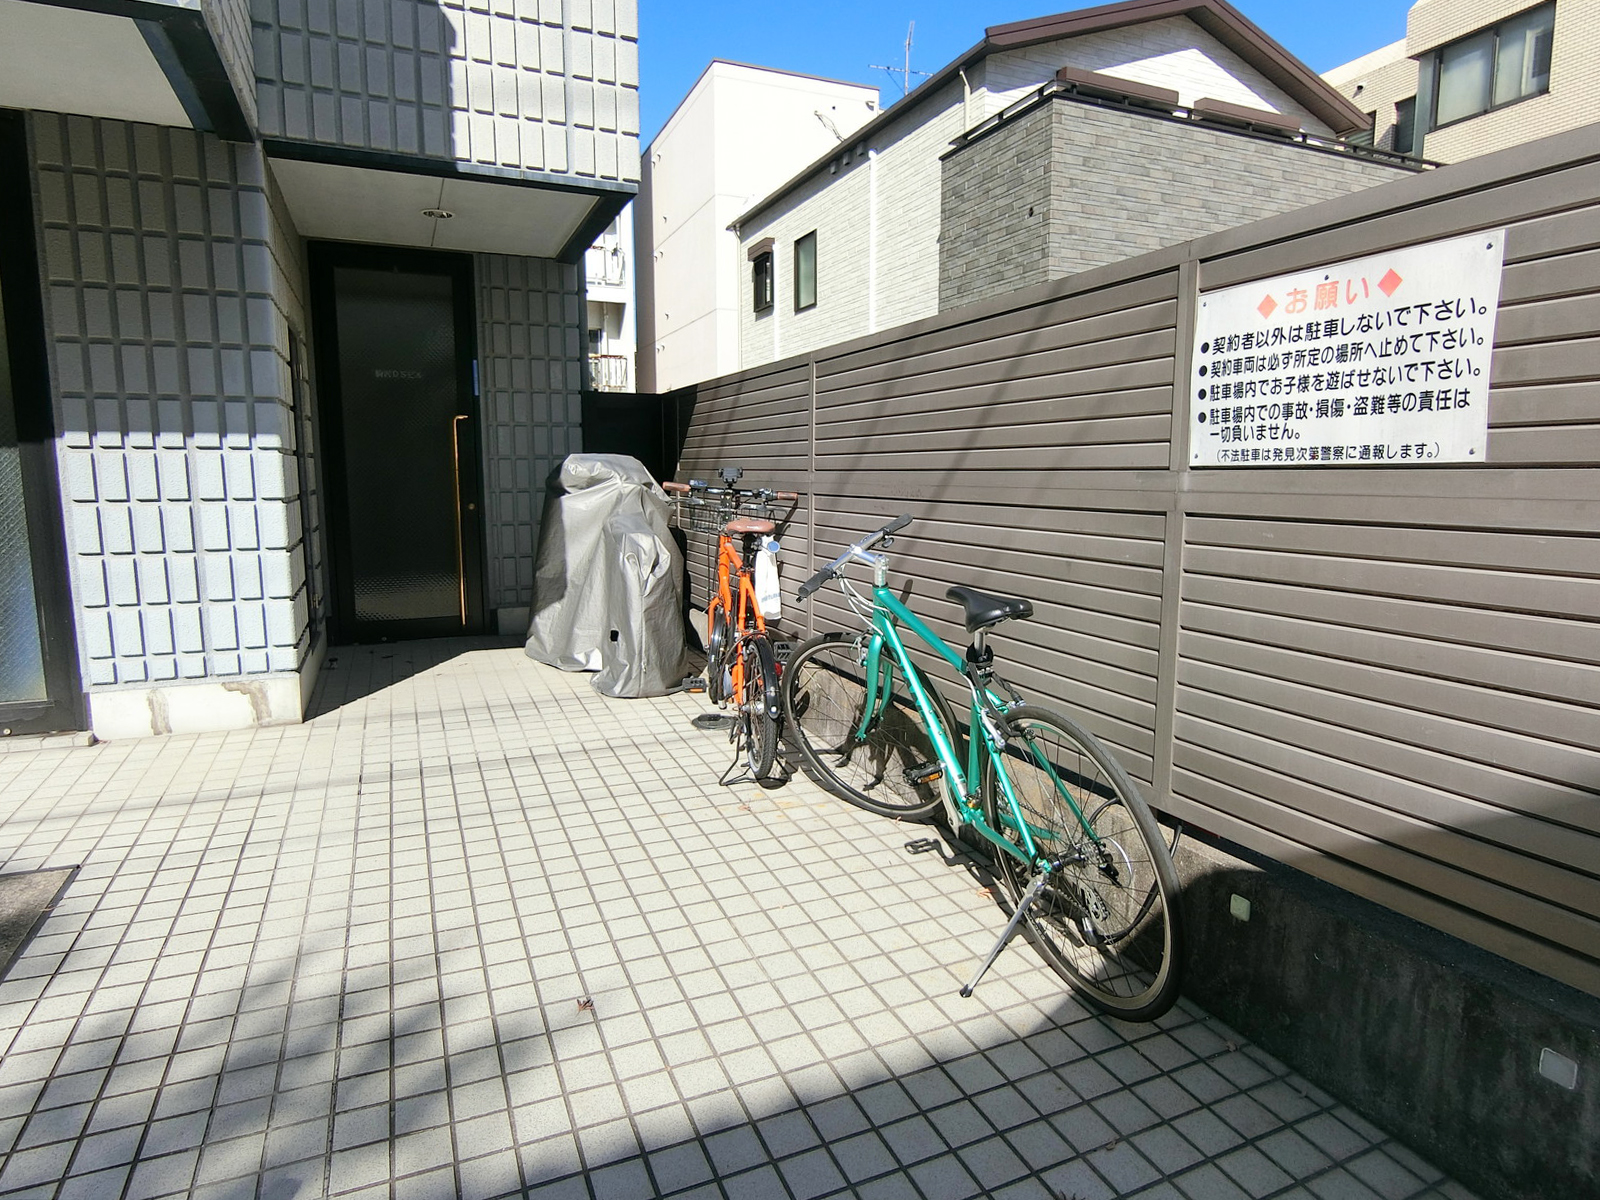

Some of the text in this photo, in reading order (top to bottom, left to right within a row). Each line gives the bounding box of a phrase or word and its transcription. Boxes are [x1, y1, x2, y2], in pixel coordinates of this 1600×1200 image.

[1284, 277, 1369, 314] お願い
[1212, 297, 1487, 355] 契約者以外は駐車しないで下さい。
[1210, 327, 1484, 379] 契約車両は必ず所定の場所へ止めて下さい。
[1209, 358, 1481, 401] 駐車場内でお子様を遊ばせないで下さい。
[1210, 422, 1301, 443] 一切負いません。
